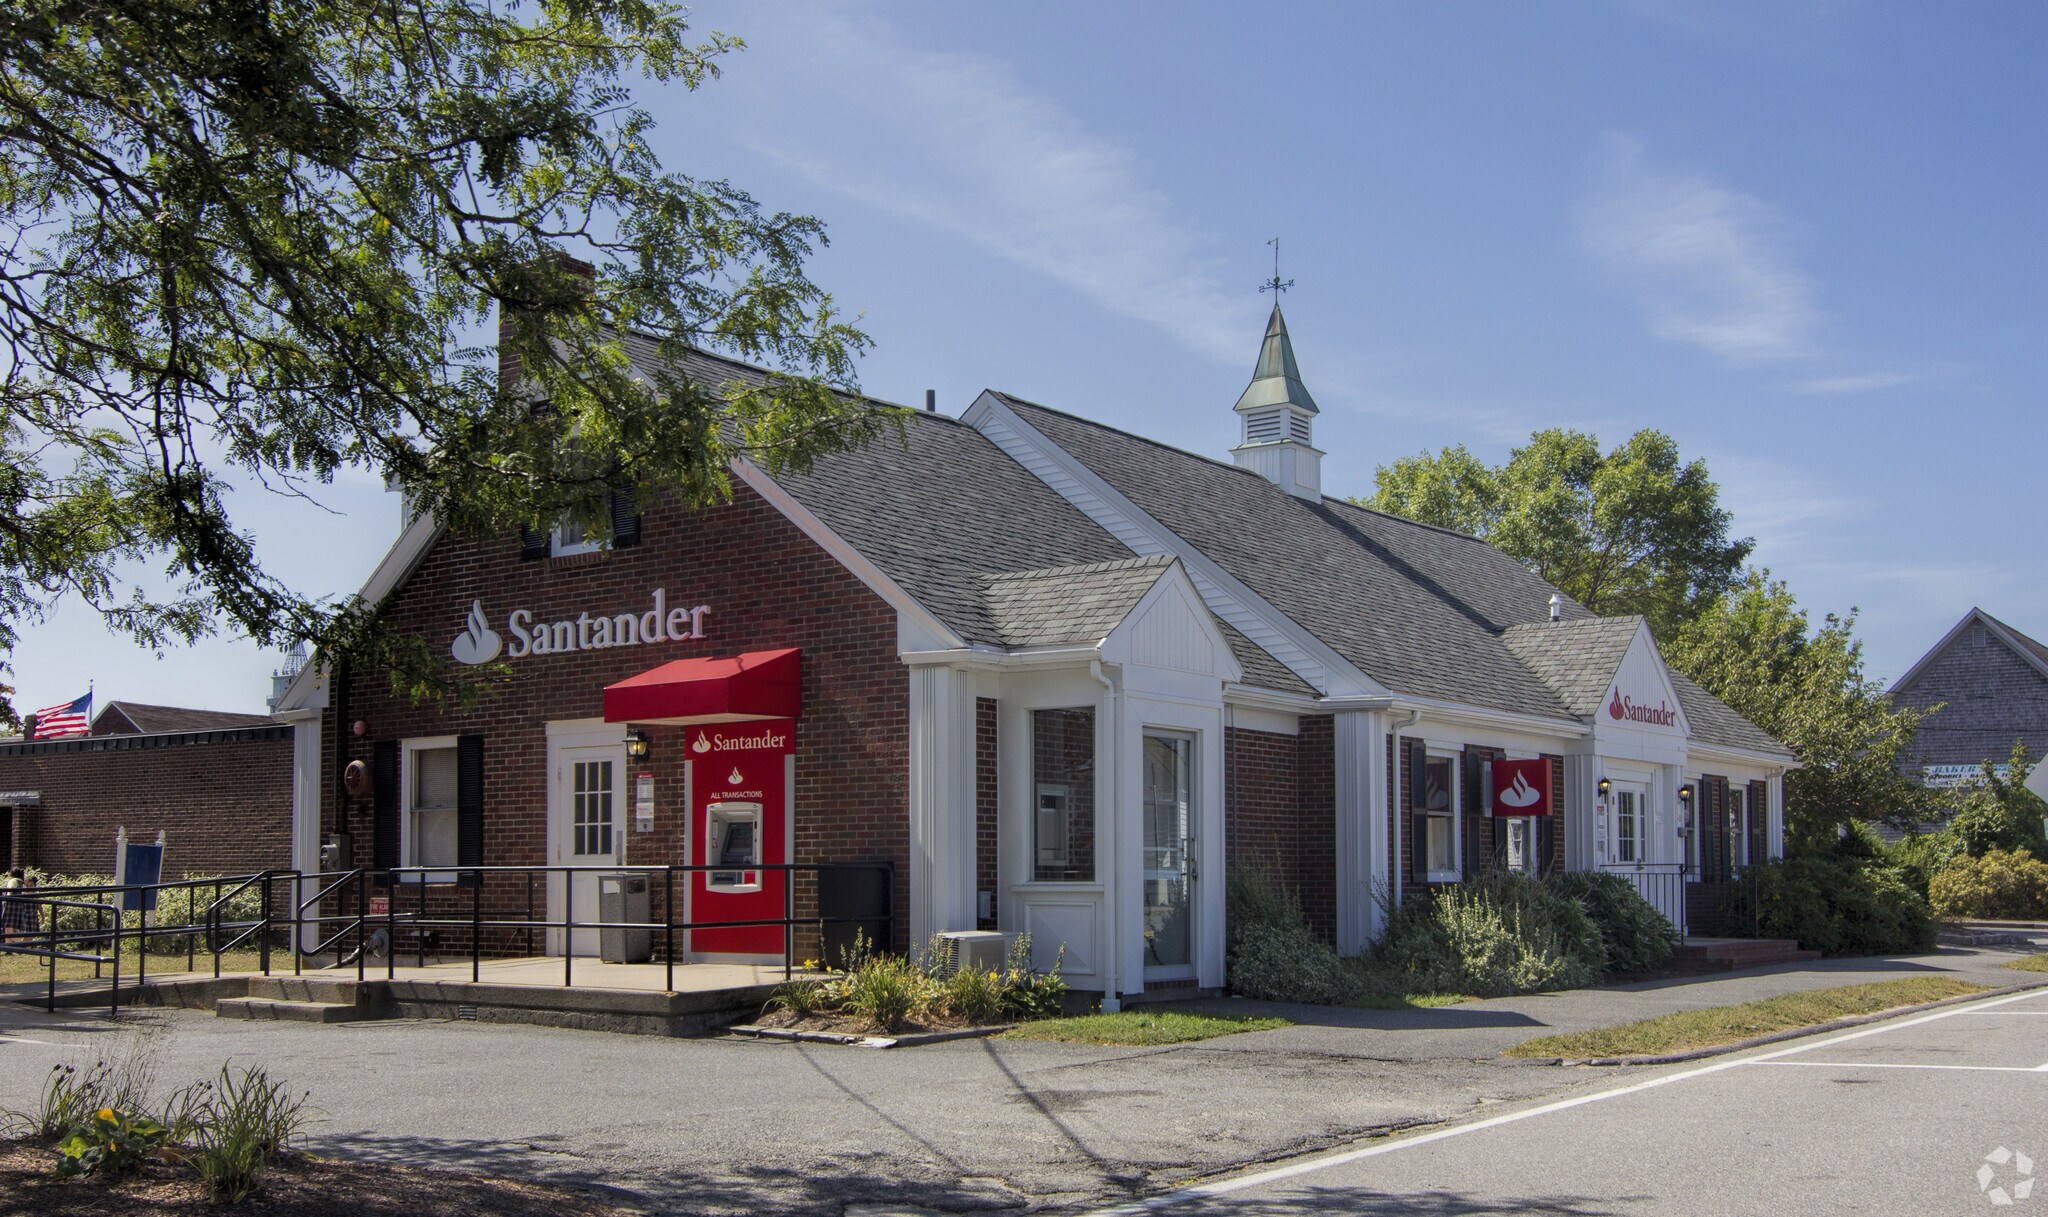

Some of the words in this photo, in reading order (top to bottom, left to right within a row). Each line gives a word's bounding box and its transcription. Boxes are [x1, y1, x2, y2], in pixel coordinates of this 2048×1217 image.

[509, 588, 711, 657] Santander
[1624, 695, 1676, 727] Santander
[713, 729, 786, 751] Santander
[721, 791, 763, 799] TRANSACTIONS
